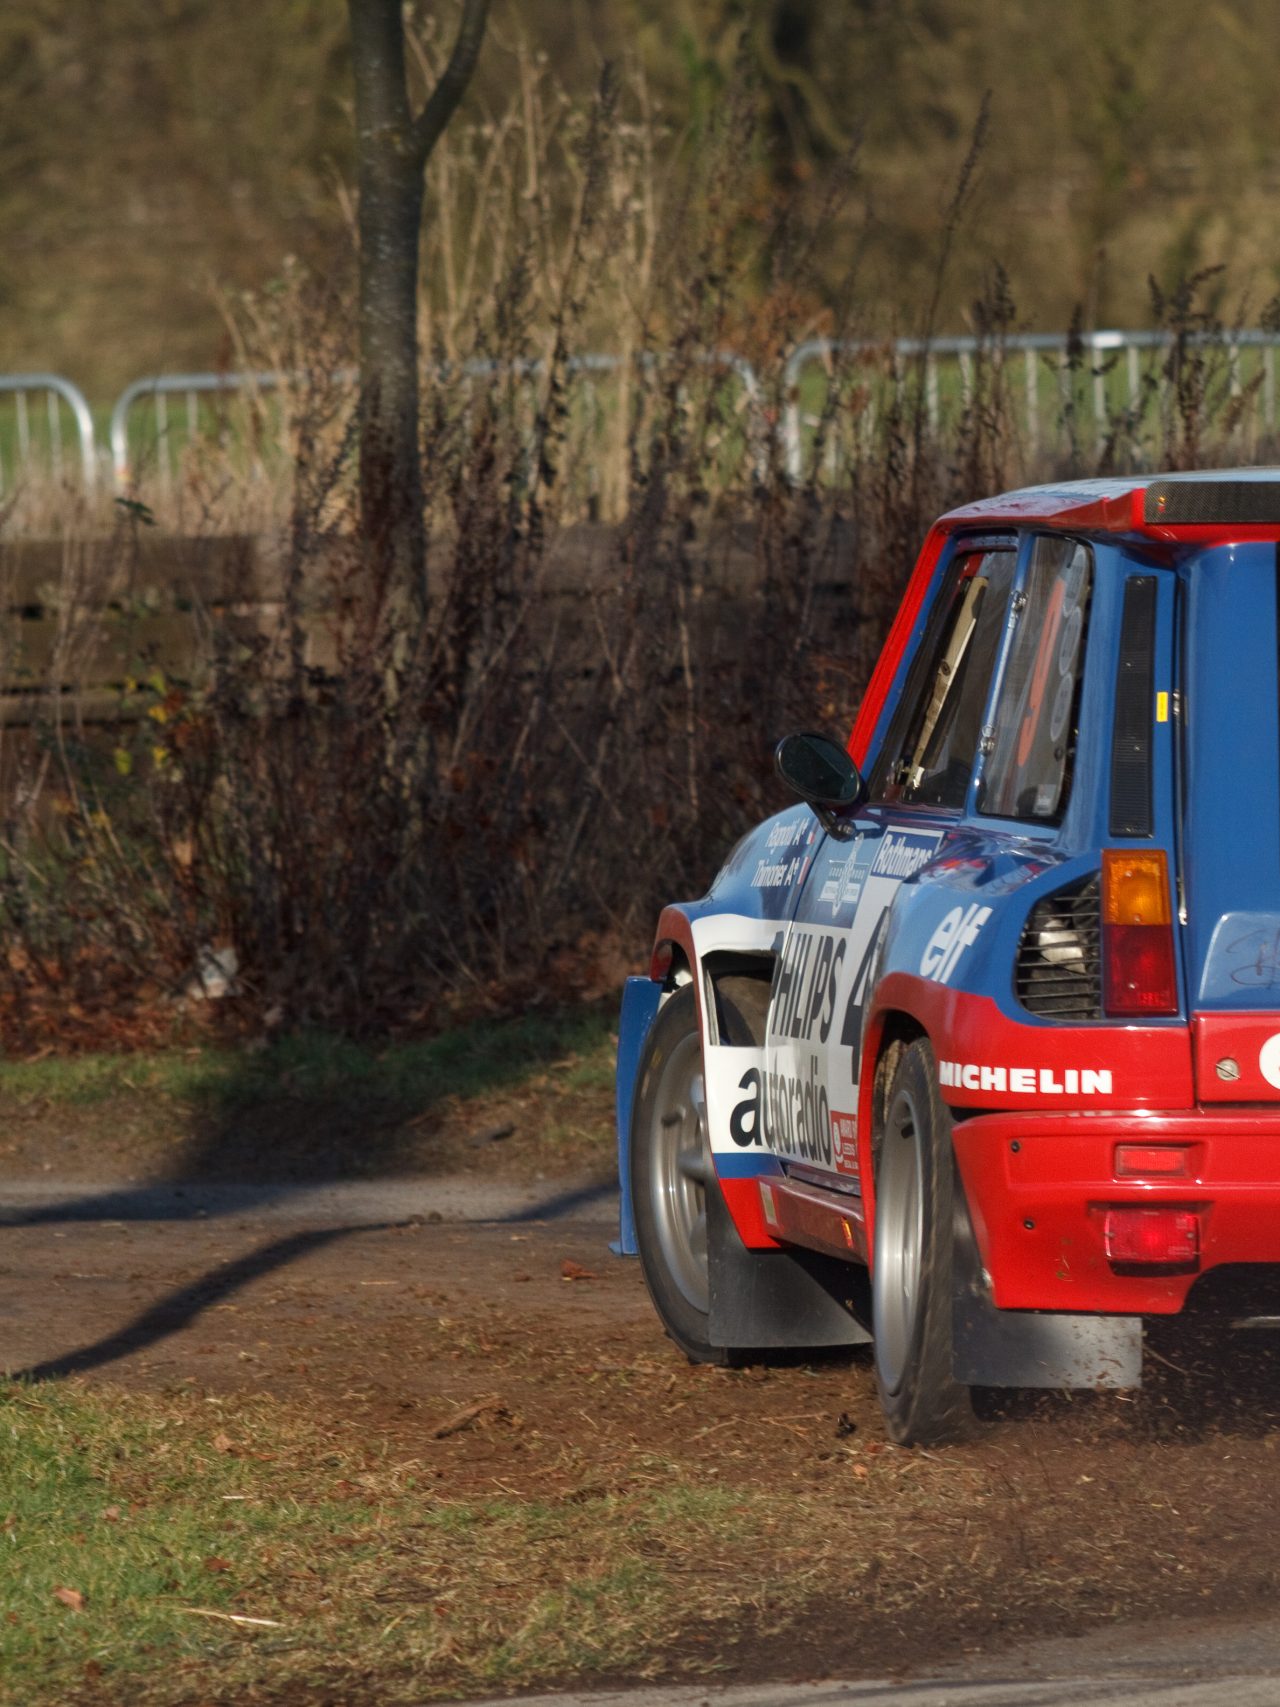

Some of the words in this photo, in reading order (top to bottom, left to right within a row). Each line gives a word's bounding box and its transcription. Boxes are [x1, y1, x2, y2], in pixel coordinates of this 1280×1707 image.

[920, 903, 994, 984] elf
[730, 1053, 832, 1166] autoradio
[939, 1060, 1113, 1095] MICHELIN
